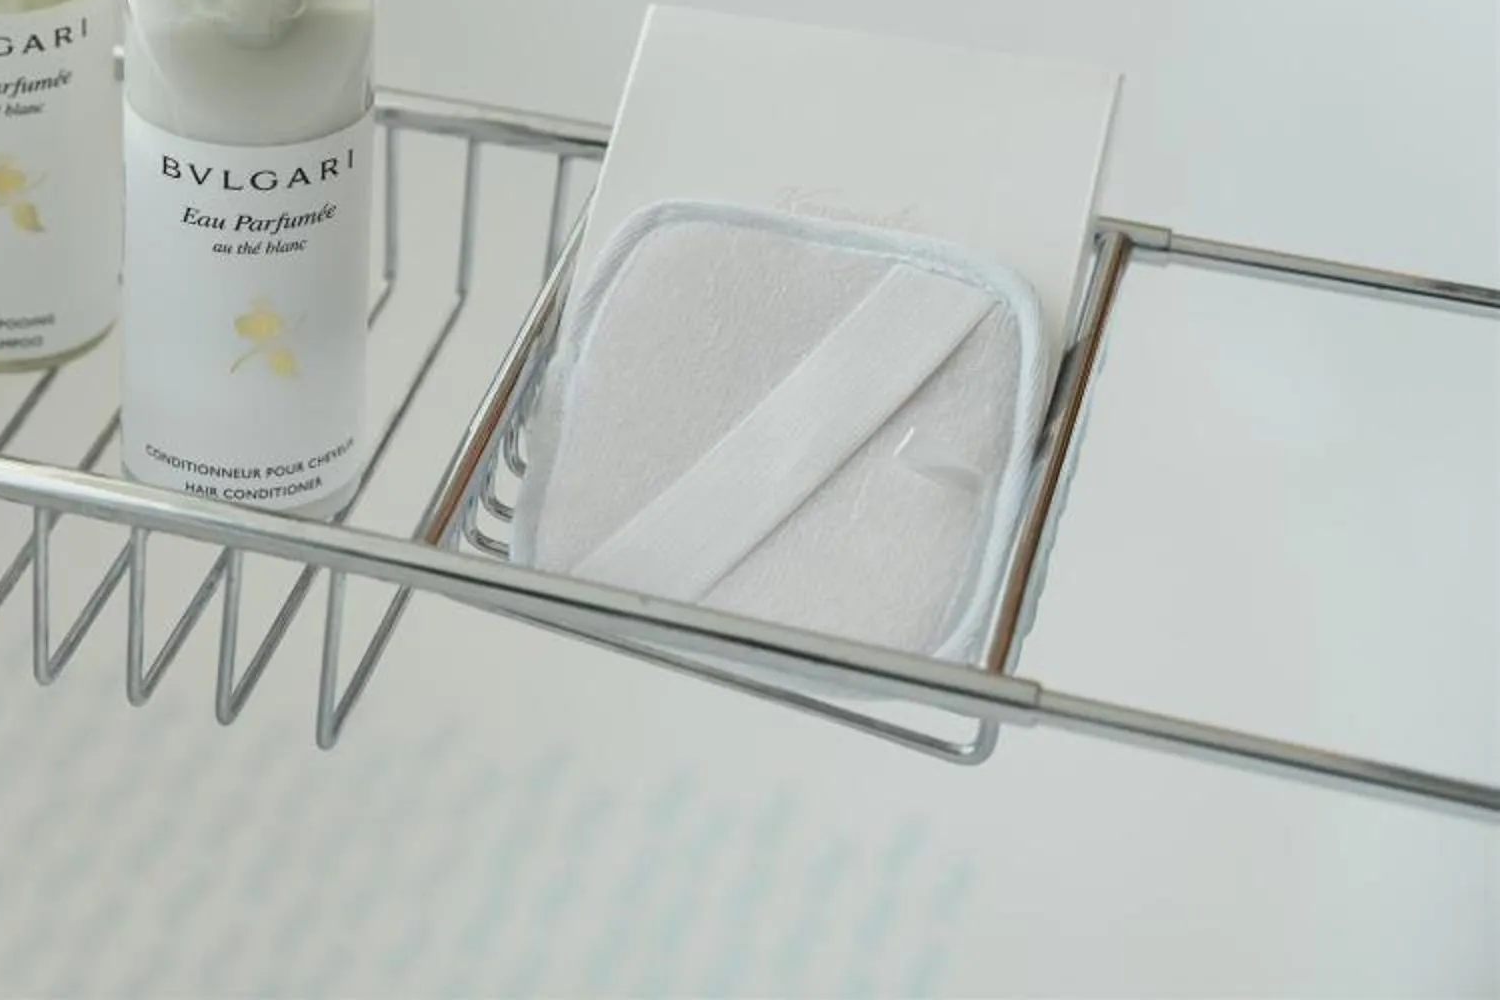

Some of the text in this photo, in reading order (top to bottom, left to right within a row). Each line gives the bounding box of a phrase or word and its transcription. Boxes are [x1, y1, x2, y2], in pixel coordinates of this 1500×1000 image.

[161, 148, 354, 192] BVLGARI
[182, 202, 337, 235] Eau Parfumée
[211, 237, 309, 256] au thé blanc
[145, 444, 262, 480] CONDITIONNEUR
[265, 461, 304, 479] POUR
[185, 475, 323, 500] HAIR CONDITIONER
